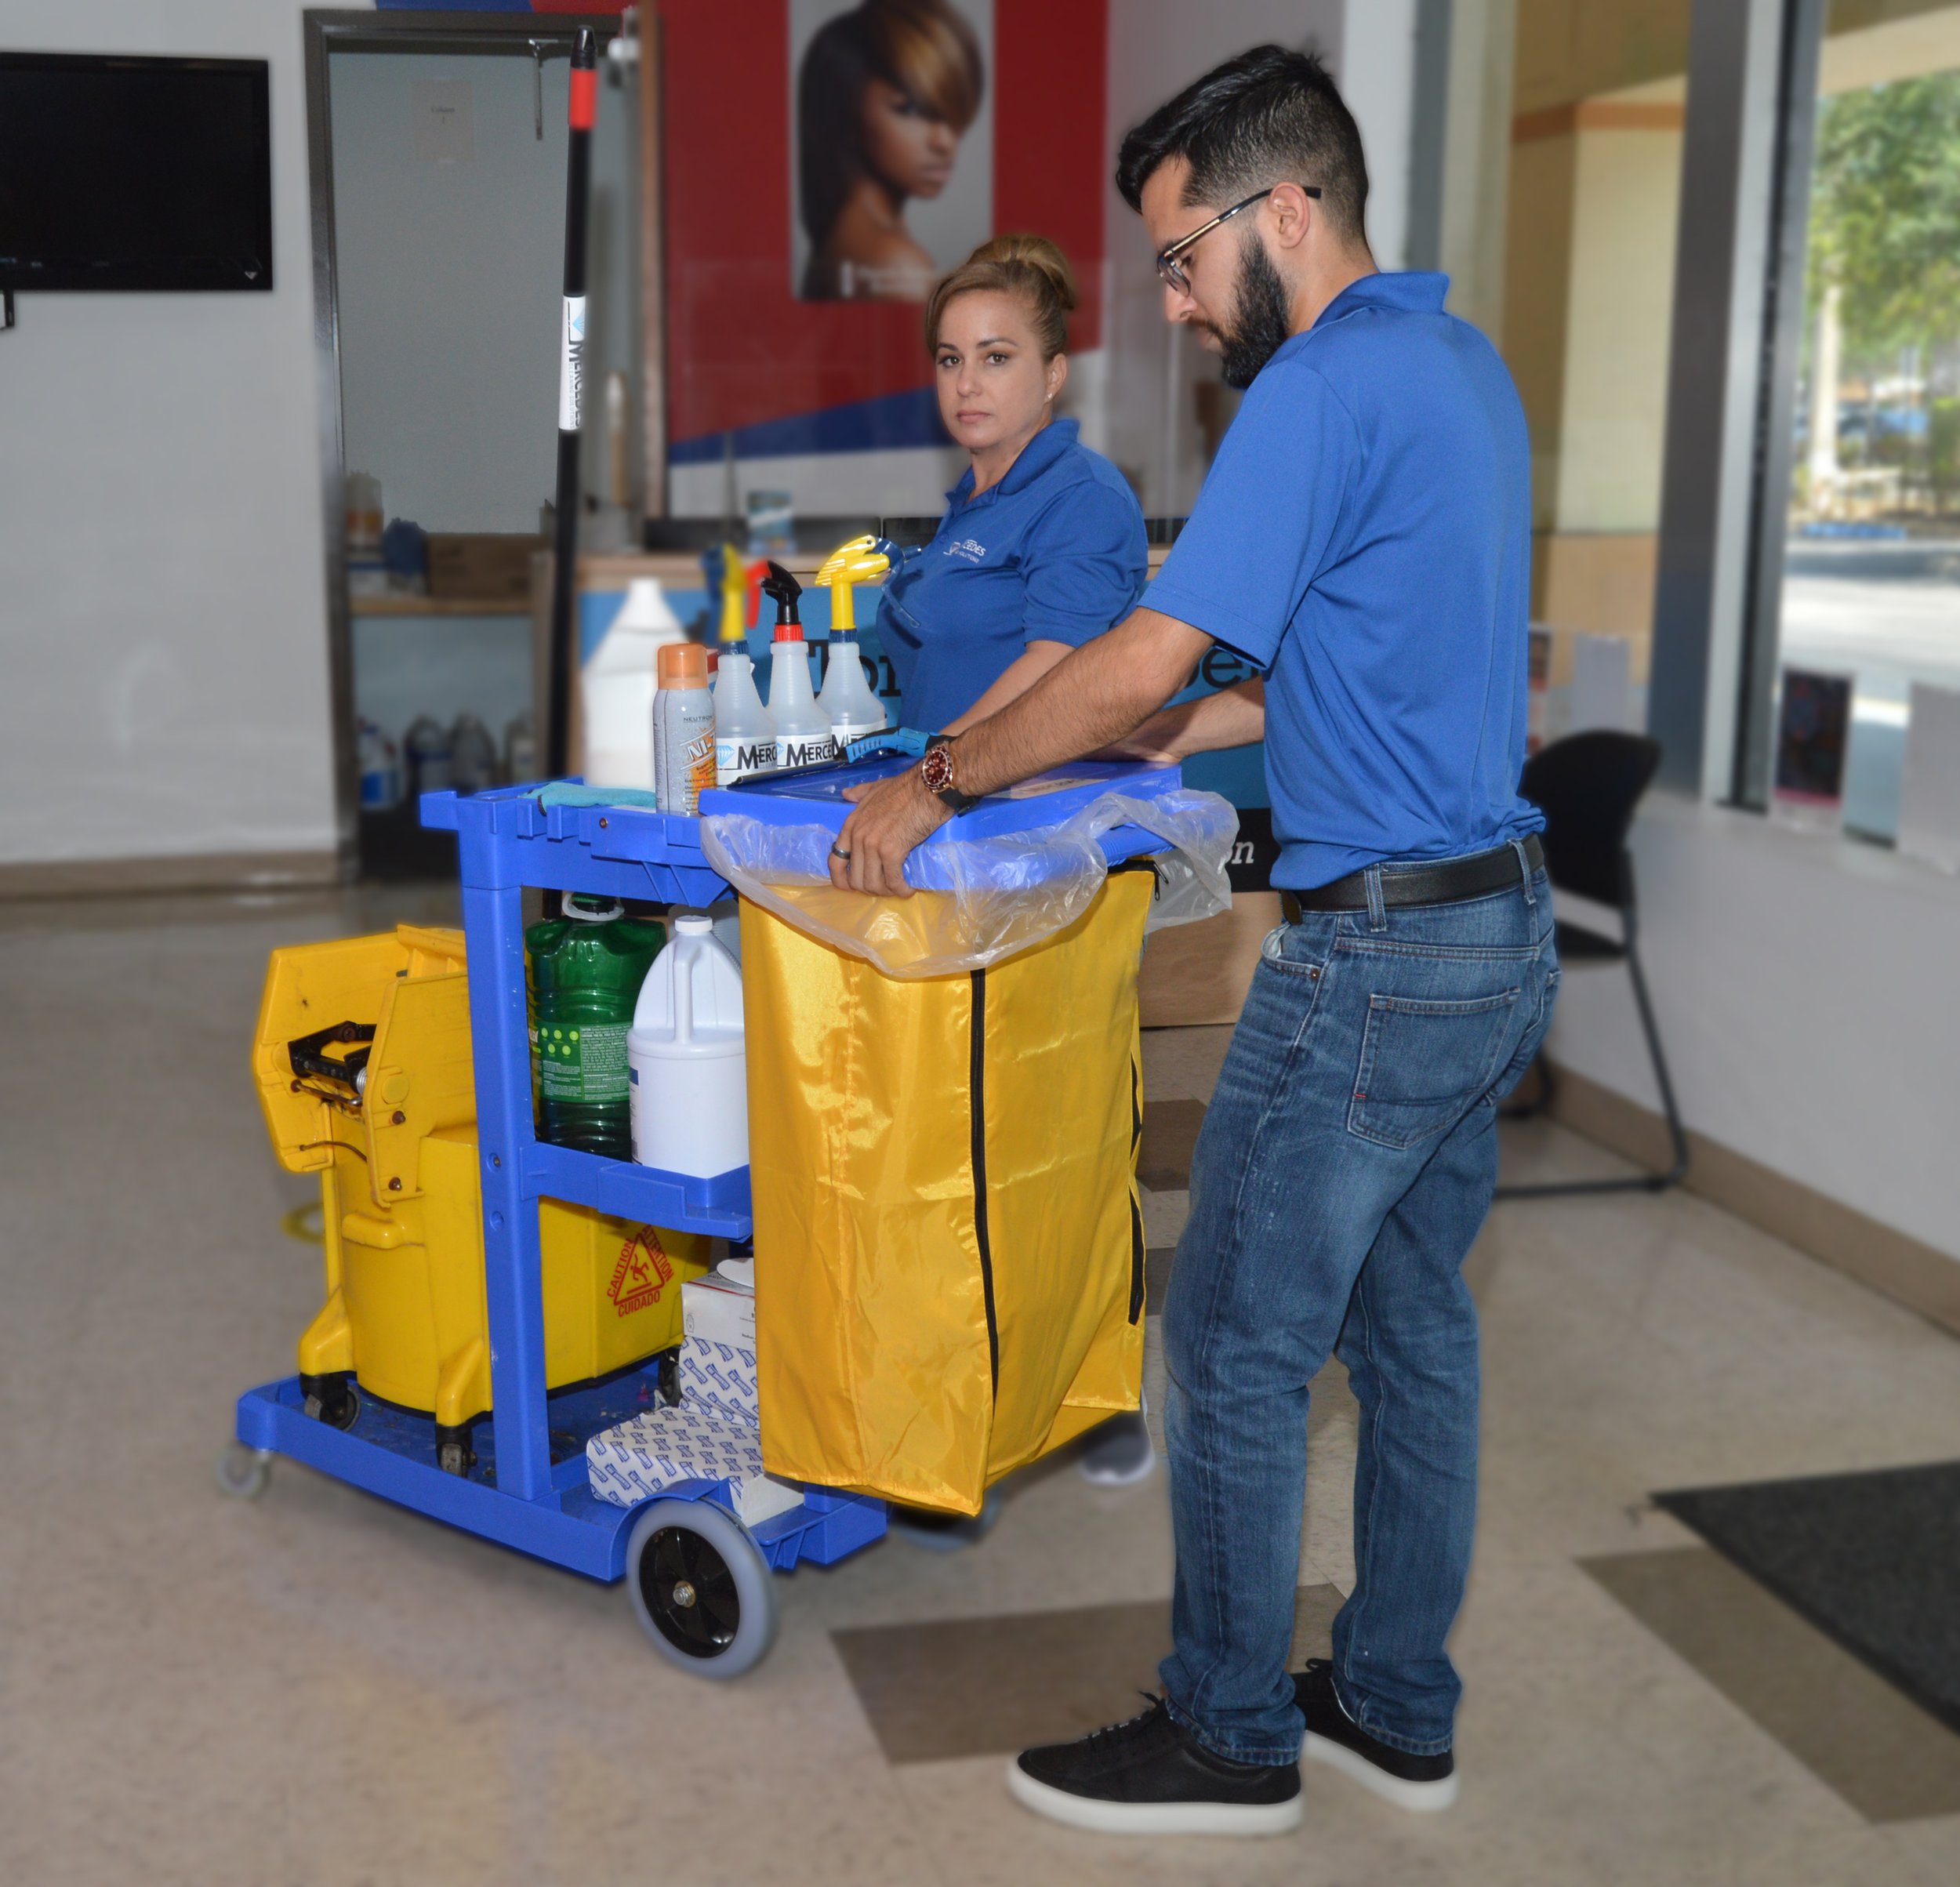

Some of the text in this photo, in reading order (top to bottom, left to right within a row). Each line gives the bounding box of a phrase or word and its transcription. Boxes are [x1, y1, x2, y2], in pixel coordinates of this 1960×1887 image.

[738, 745, 777, 770] MERC
[786, 742, 832, 768] MERCE
[607, 1238, 634, 1298] CAUTION
[618, 1290, 660, 1318] CUIDADO
